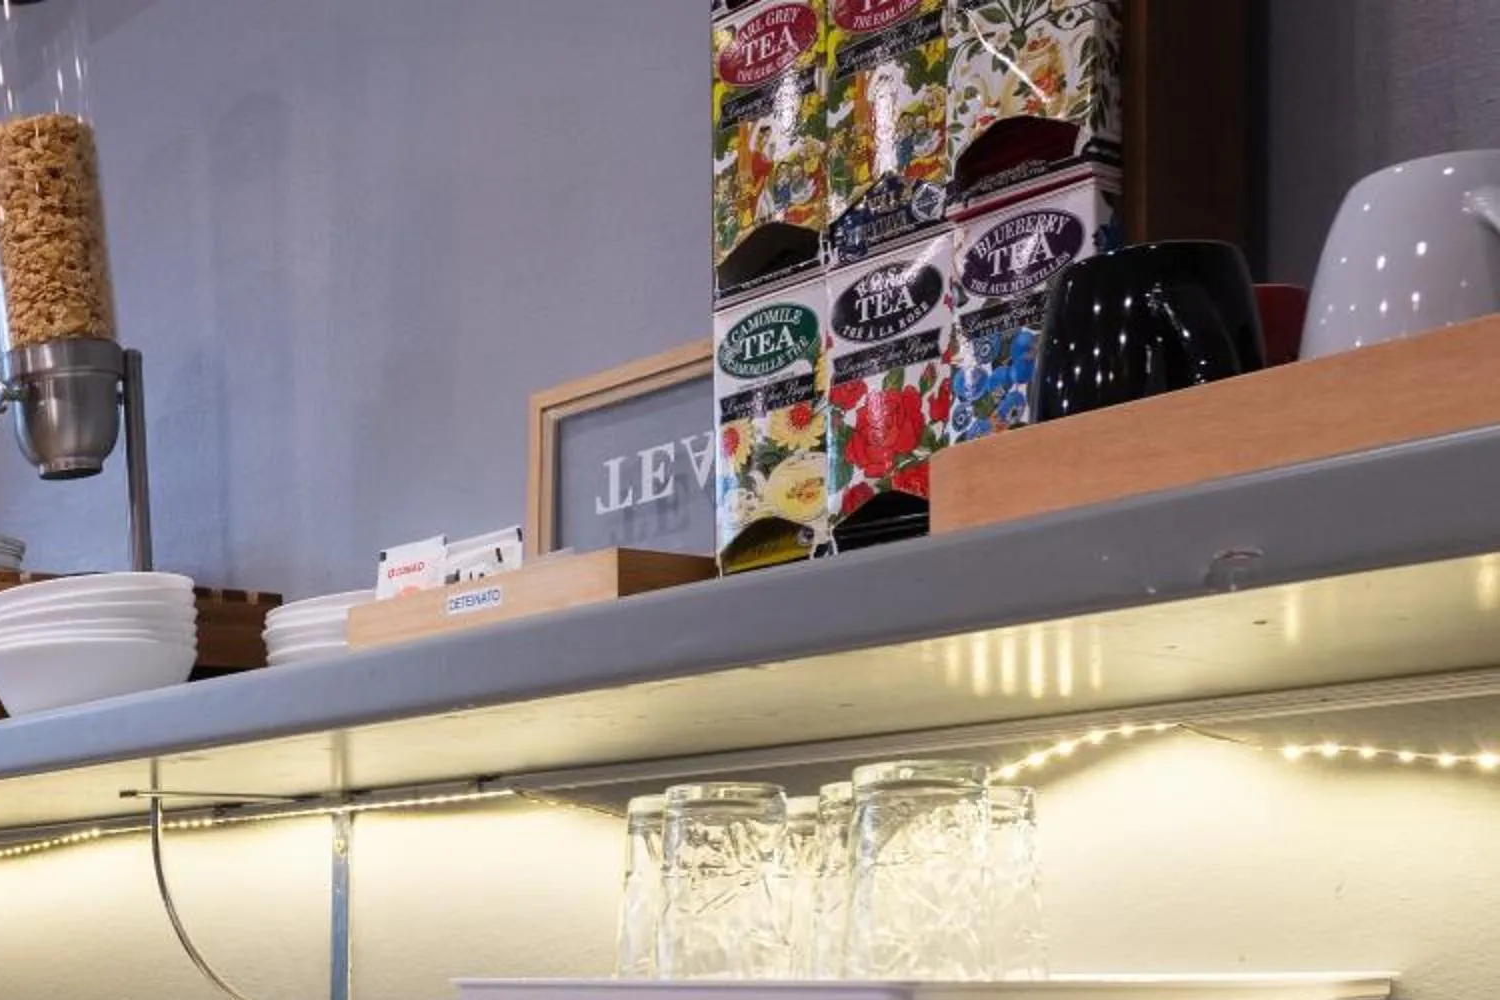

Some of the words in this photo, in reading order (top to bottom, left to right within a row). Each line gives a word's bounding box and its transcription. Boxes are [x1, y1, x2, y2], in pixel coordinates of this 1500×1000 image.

[741, 25, 800, 67] TEA
[975, 213, 1071, 259] BLUEBERRY
[987, 228, 1055, 277] TEA
[855, 285, 916, 322] TEA
[731, 307, 803, 342] CAMOMILE
[739, 324, 795, 361] TEA
